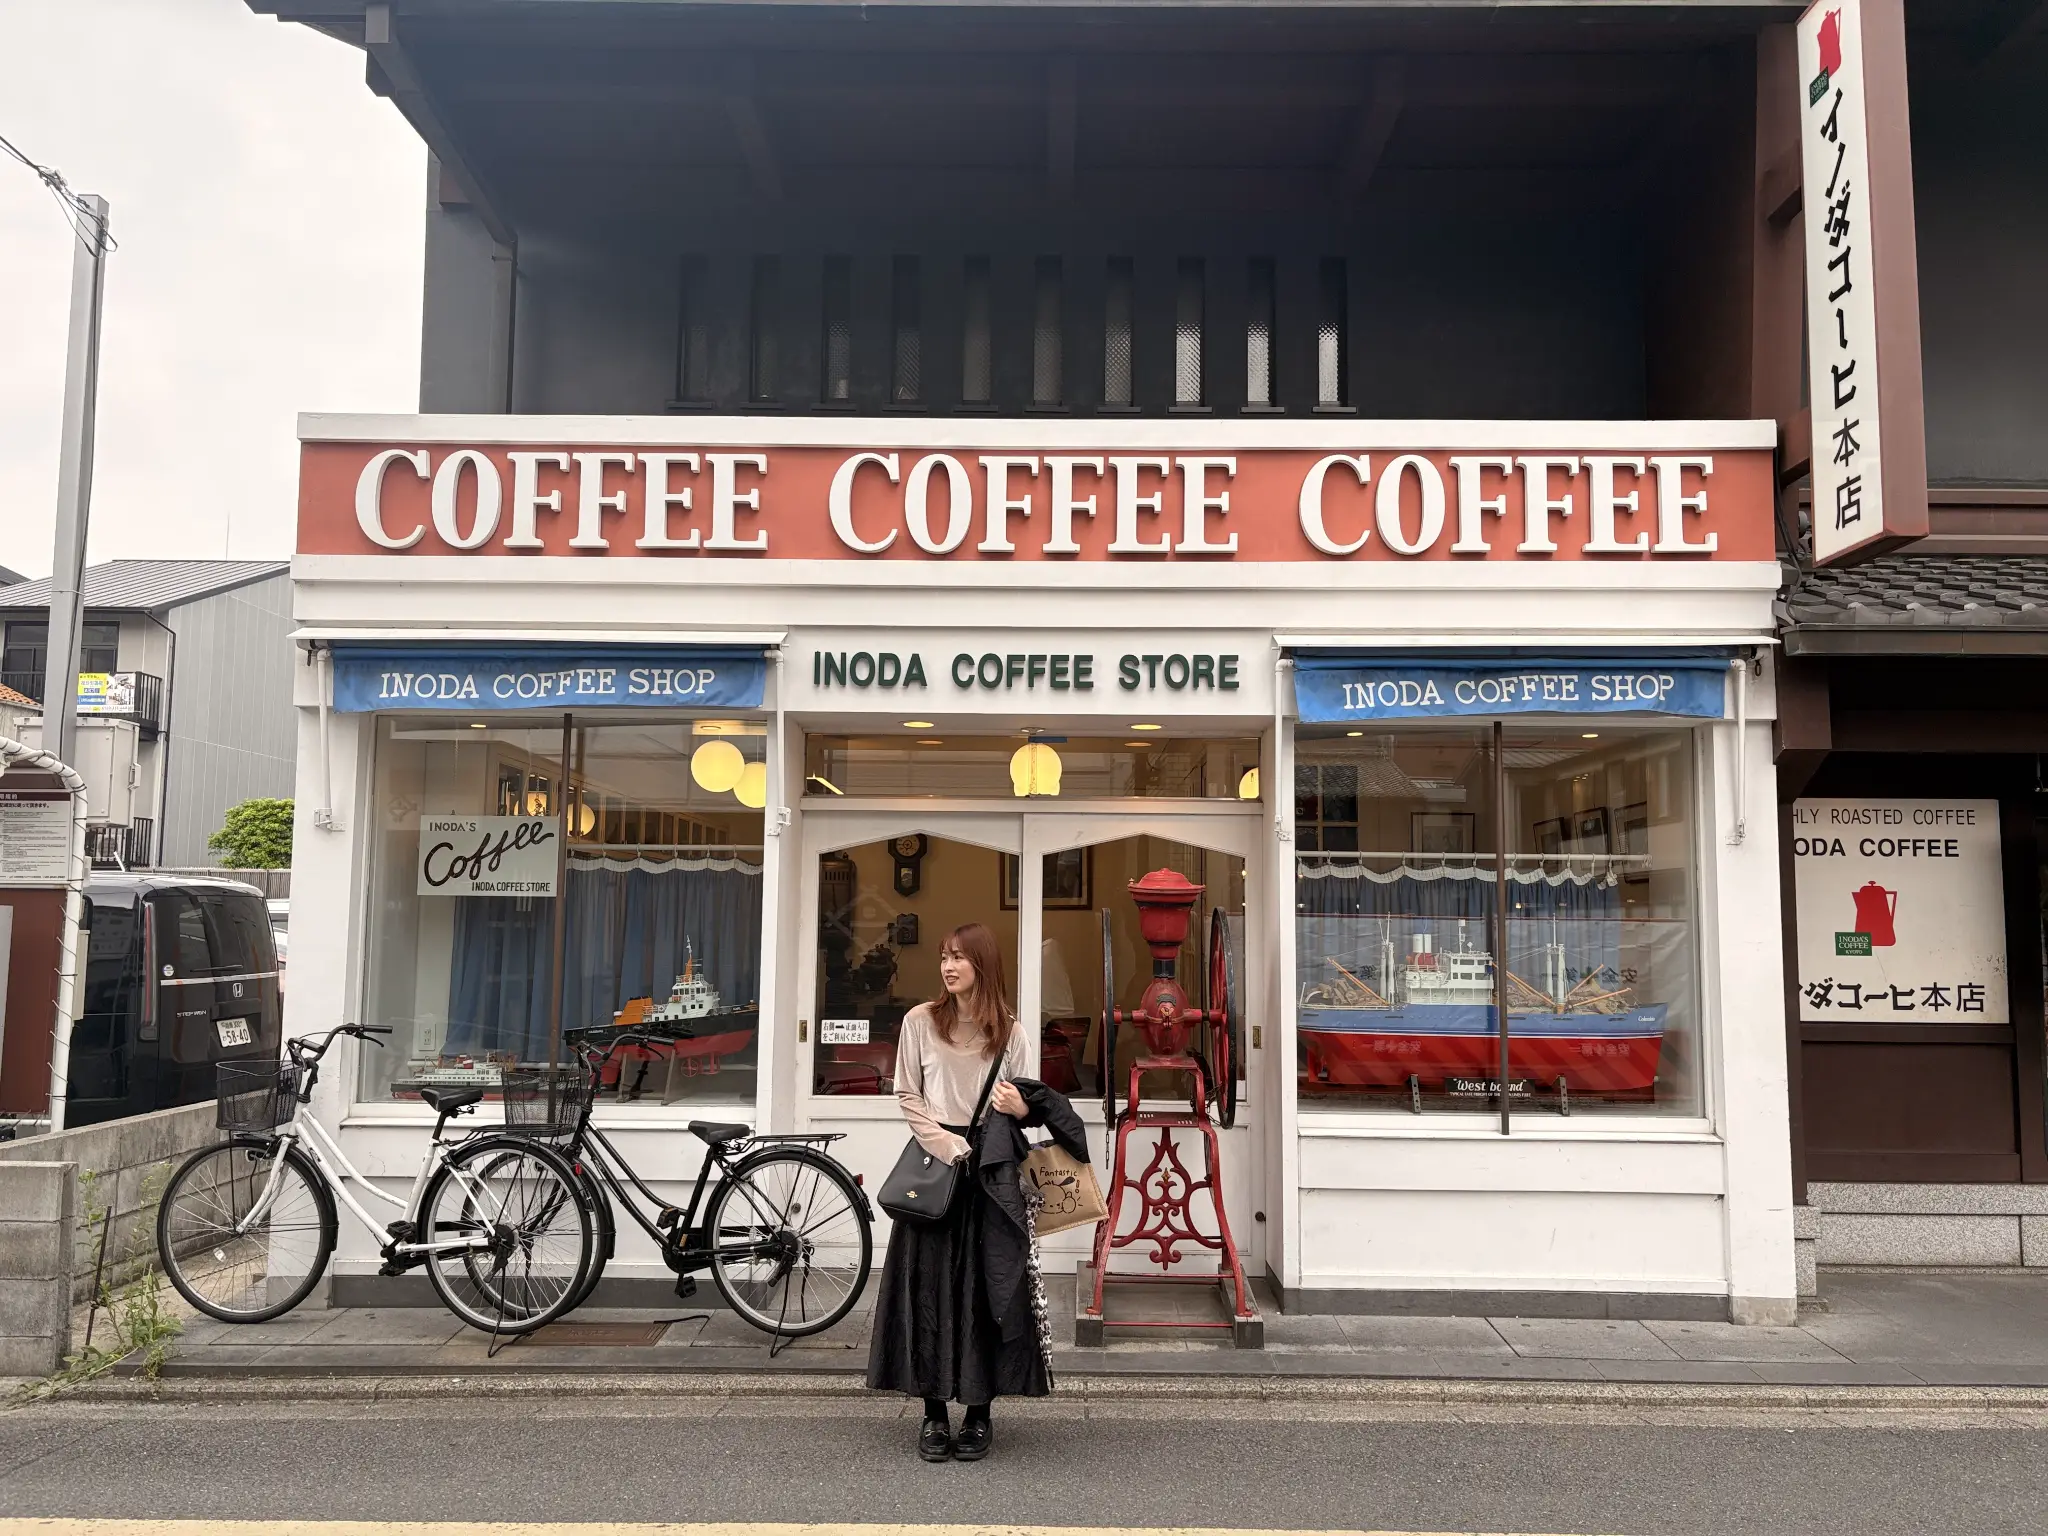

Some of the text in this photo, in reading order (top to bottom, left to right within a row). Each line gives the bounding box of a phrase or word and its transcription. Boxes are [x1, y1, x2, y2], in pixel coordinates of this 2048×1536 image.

[1820, 88, 1861, 530] イノダコーヒ本店
[355, 449, 1717, 556] COFFEE COFFEE COFFEE
[814, 651, 1239, 690] INODA COFFEE STORE
[379, 669, 715, 699] INODA COFFEE SHOP
[1342, 675, 1675, 710] INODA COFFEE SHOP
[1831, 808, 1903, 825] ROASTED
[1913, 809, 1976, 826] COFFEE
[429, 822, 477, 832] INODA'S
[424, 821, 555, 886] Coffee
[1859, 838, 1960, 857] COFFEE
[471, 882, 550, 892] INODA COFFEE STORE
[1838, 935, 1869, 943] INODA'S
[1799, 977, 1986, 1012] ダコーヒ本店
[823, 1021, 835, 1032] 右側
[822, 1032, 868, 1042] をご利用ください
[1040, 1167, 1078, 1177] Fantastic
